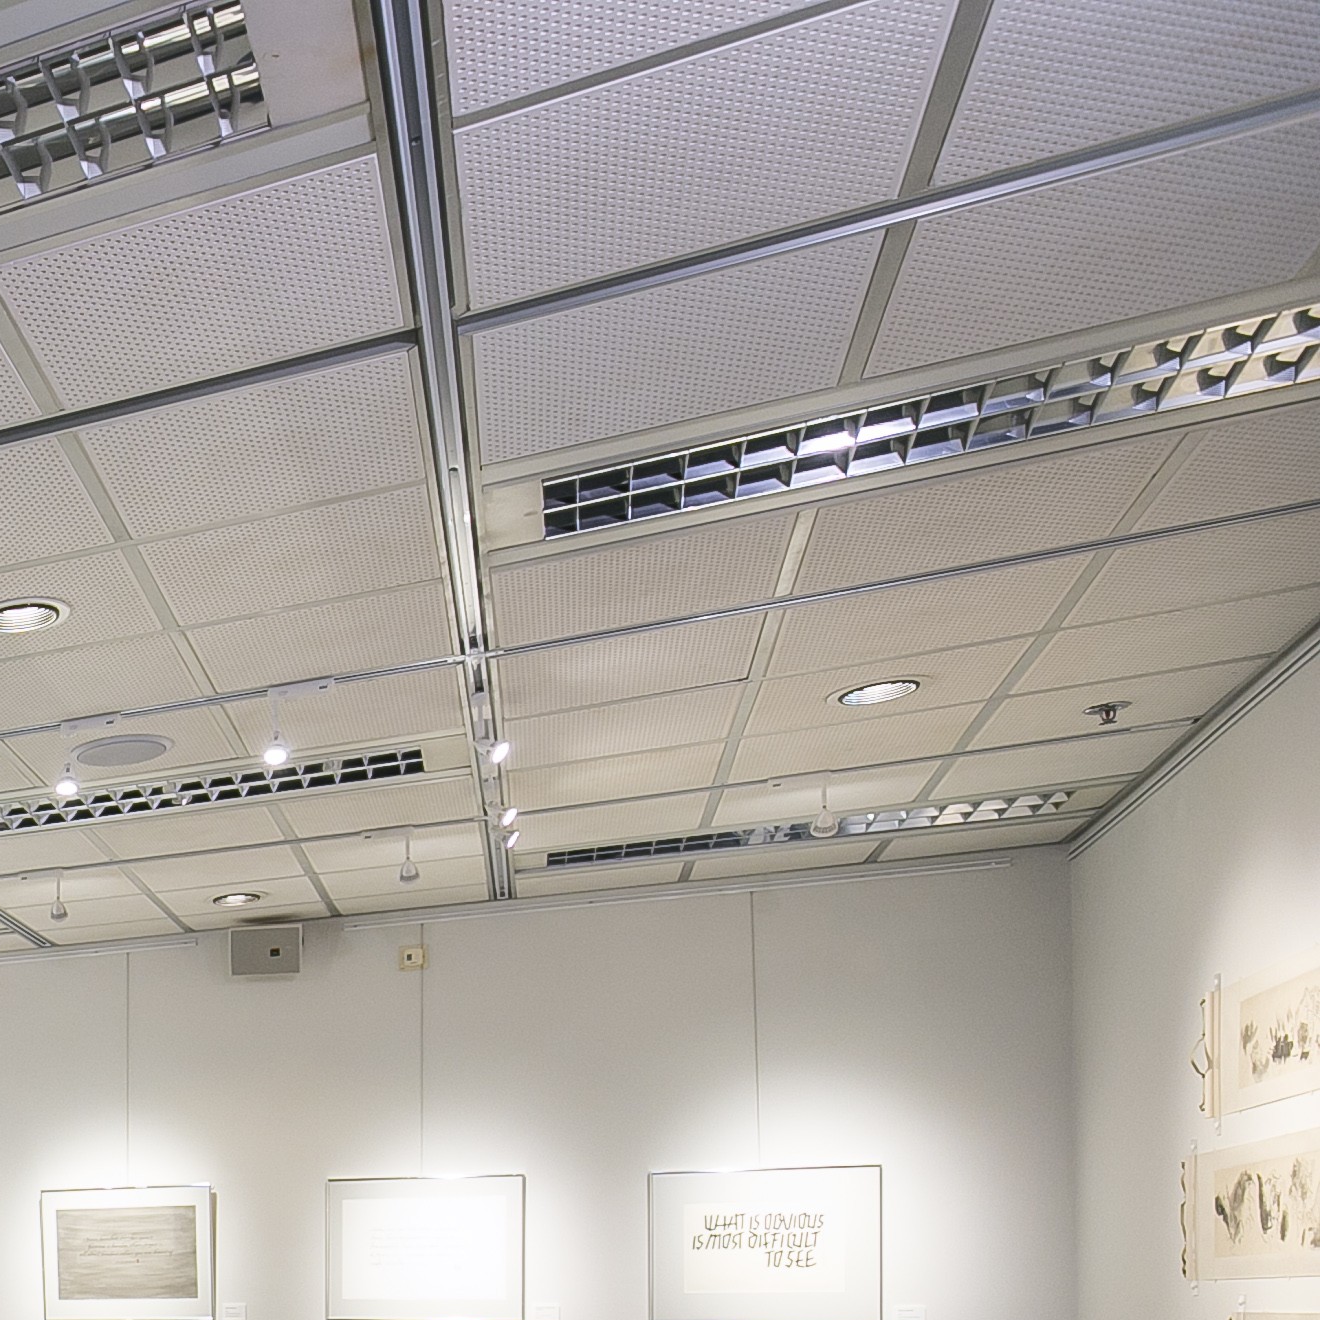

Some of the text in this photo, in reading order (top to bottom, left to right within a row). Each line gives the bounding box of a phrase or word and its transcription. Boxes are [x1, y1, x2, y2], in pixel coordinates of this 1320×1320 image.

[704, 1212, 824, 1231] WHAT IS OBVIOUS
[692, 1230, 821, 1250] IS MOST DIFFICULT
[765, 1249, 817, 1268] TO SEE
